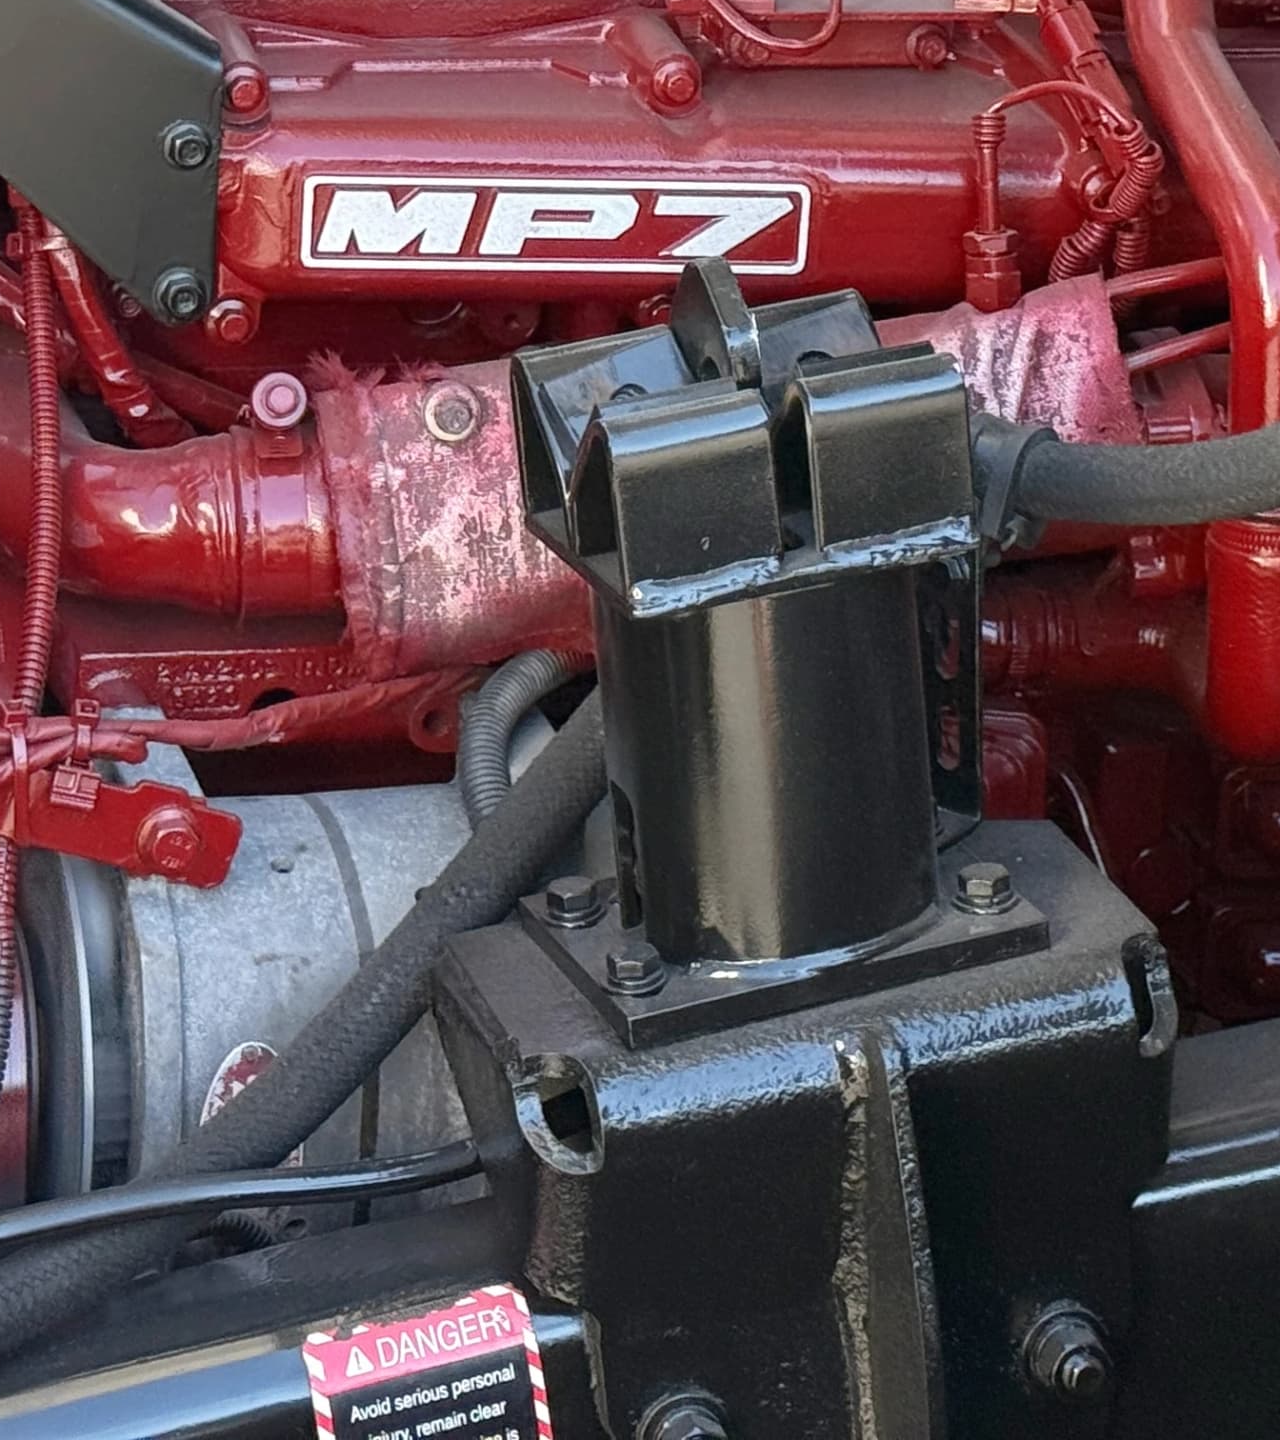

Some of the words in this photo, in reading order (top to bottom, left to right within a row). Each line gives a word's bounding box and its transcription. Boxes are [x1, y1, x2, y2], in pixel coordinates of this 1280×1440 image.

[316, 189, 794, 258] MP7
[375, 1306, 508, 1369] DANGER
[350, 1397, 392, 1424] Avoid
[393, 1384, 450, 1410] serious
[451, 1362, 516, 1401] personal
[416, 1411, 468, 1437] remain
[469, 1400, 508, 1423] clear
